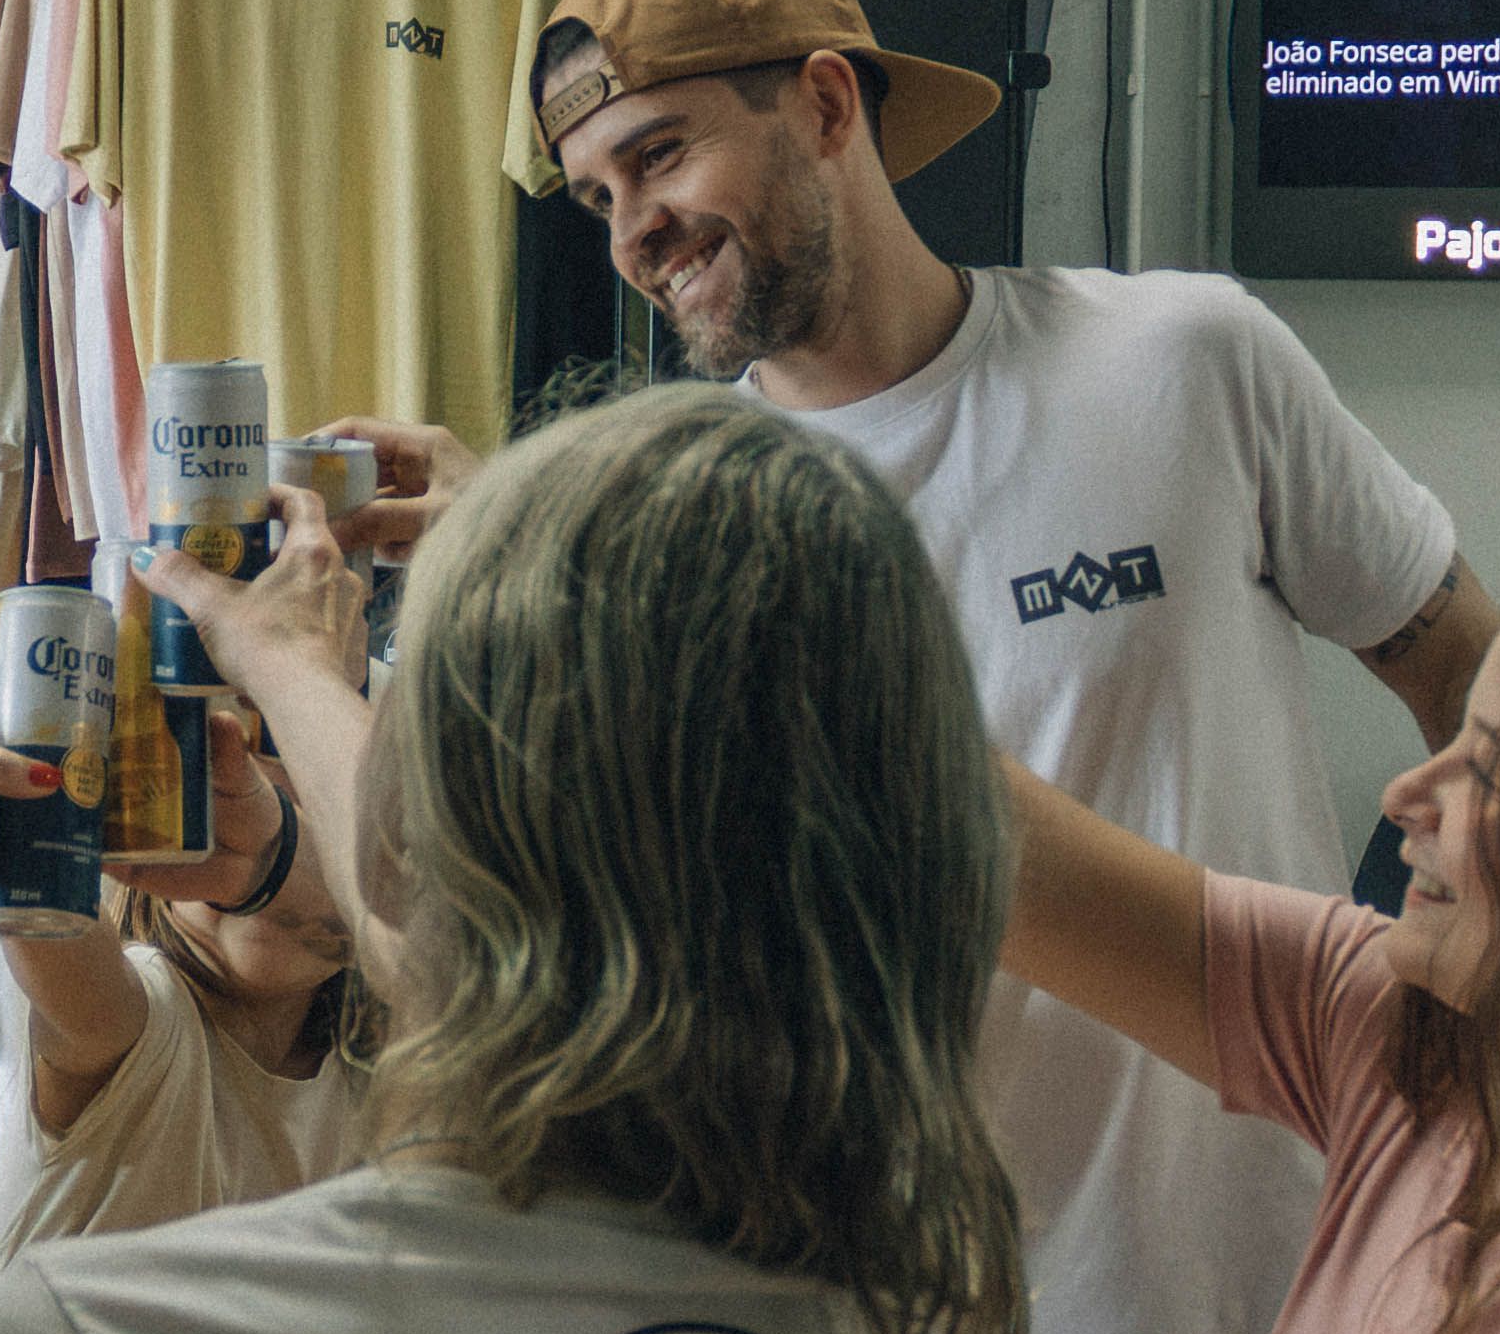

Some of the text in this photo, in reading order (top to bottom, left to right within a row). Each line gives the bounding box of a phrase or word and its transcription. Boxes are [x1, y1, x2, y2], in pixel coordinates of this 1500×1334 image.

[1263, 39, 1322, 70] João
[1329, 40, 1433, 64] Fonseca
[1265, 69, 1393, 96] eliminado
[1399, 74, 1441, 95] em
[152, 415, 265, 459] Corona
[180, 452, 248, 478] Extra
